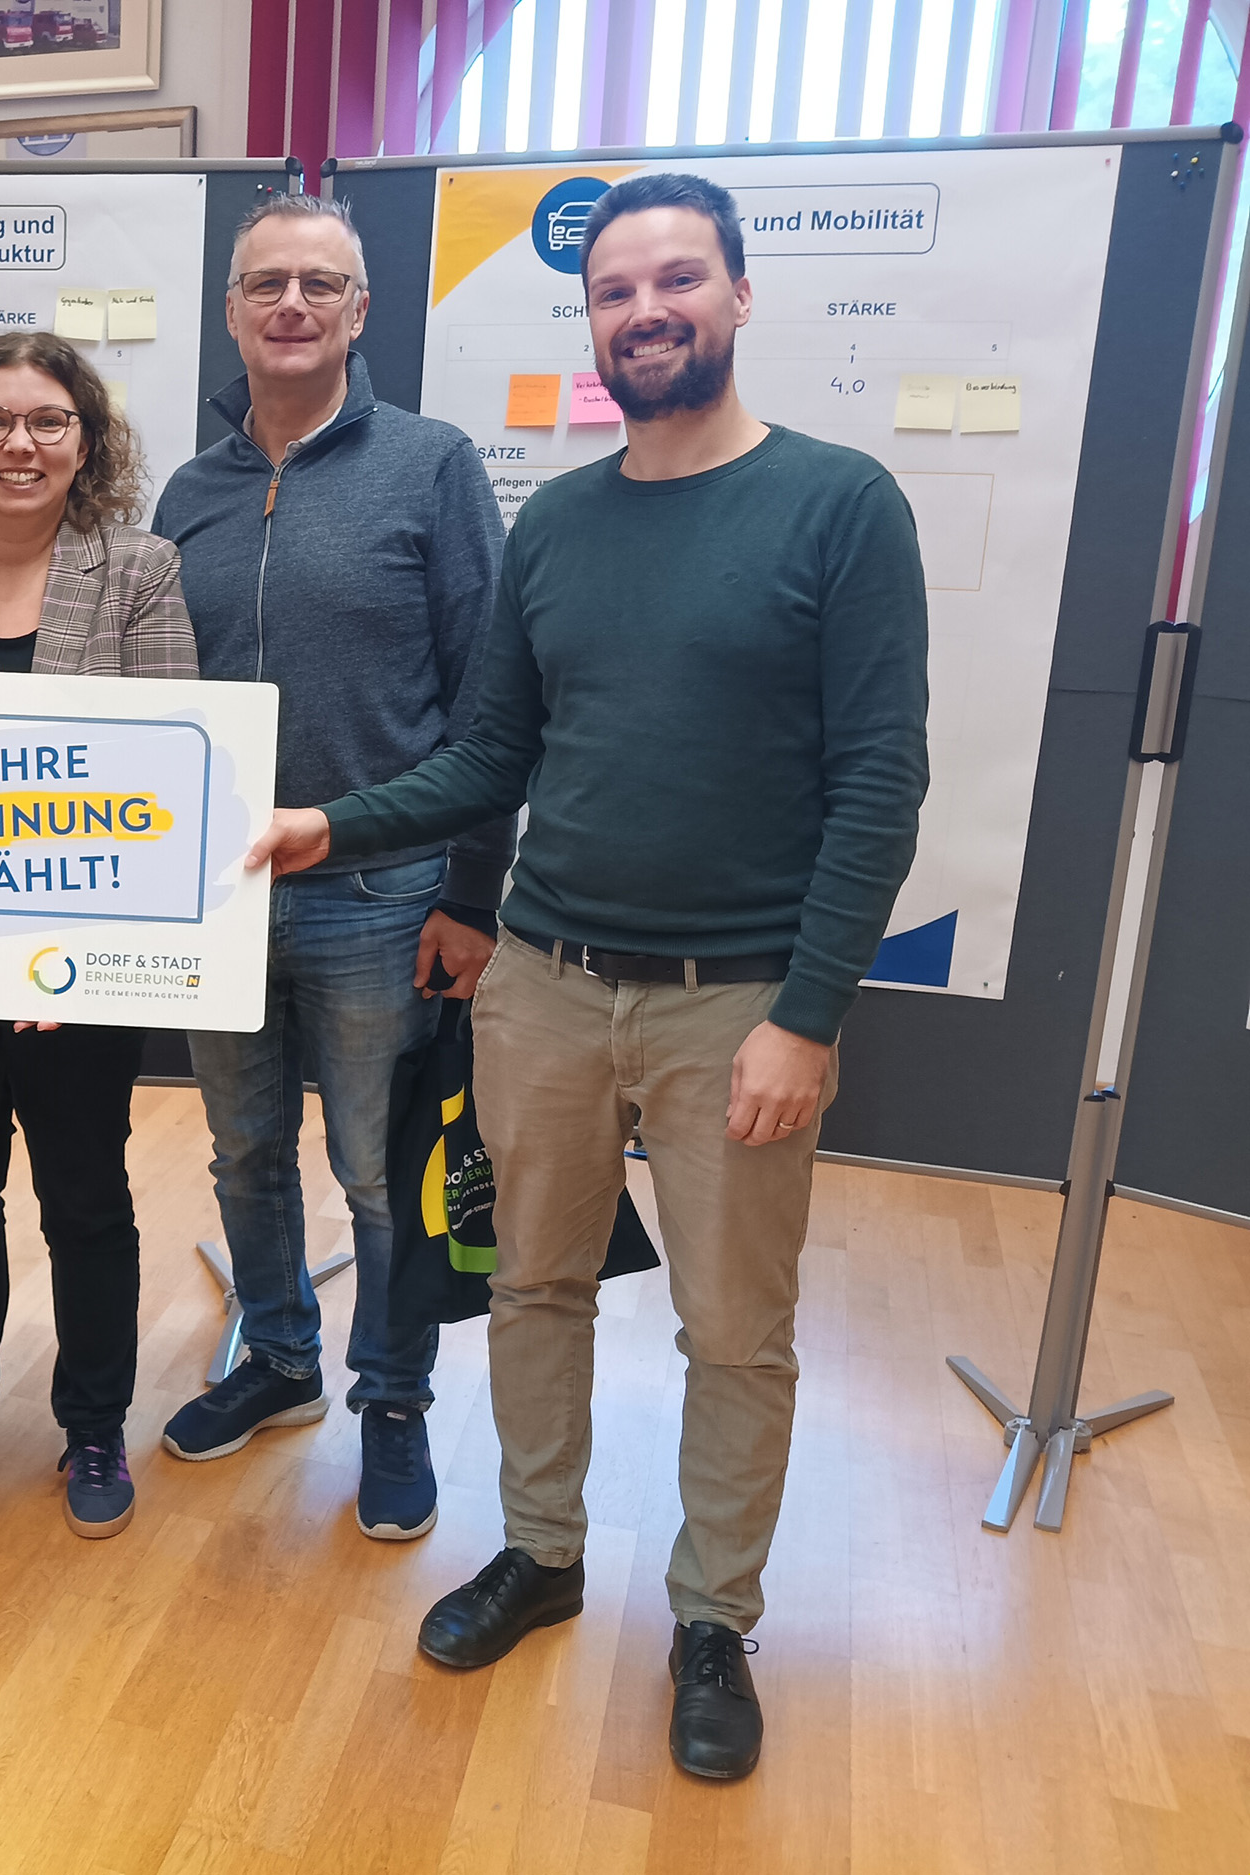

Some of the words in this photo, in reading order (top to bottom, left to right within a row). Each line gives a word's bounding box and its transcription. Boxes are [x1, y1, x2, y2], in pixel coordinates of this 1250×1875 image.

[13, 215, 55, 234] und
[753, 211, 802, 231] und
[810, 208, 925, 231] Mobilität
[826, 300, 897, 317] STÄRKE
[116, 350, 123, 358] 5
[583, 344, 589, 352] 2
[830, 376, 865, 395] 4,0
[492, 478, 532, 489] pflegen
[86, 953, 132, 966] DORF
[136, 955, 146, 968] &
[151, 956, 201, 970] STADT
[85, 971, 184, 986] ERNEUERUNG
[105, 990, 199, 1000] GEMEINDEAGENTUR
